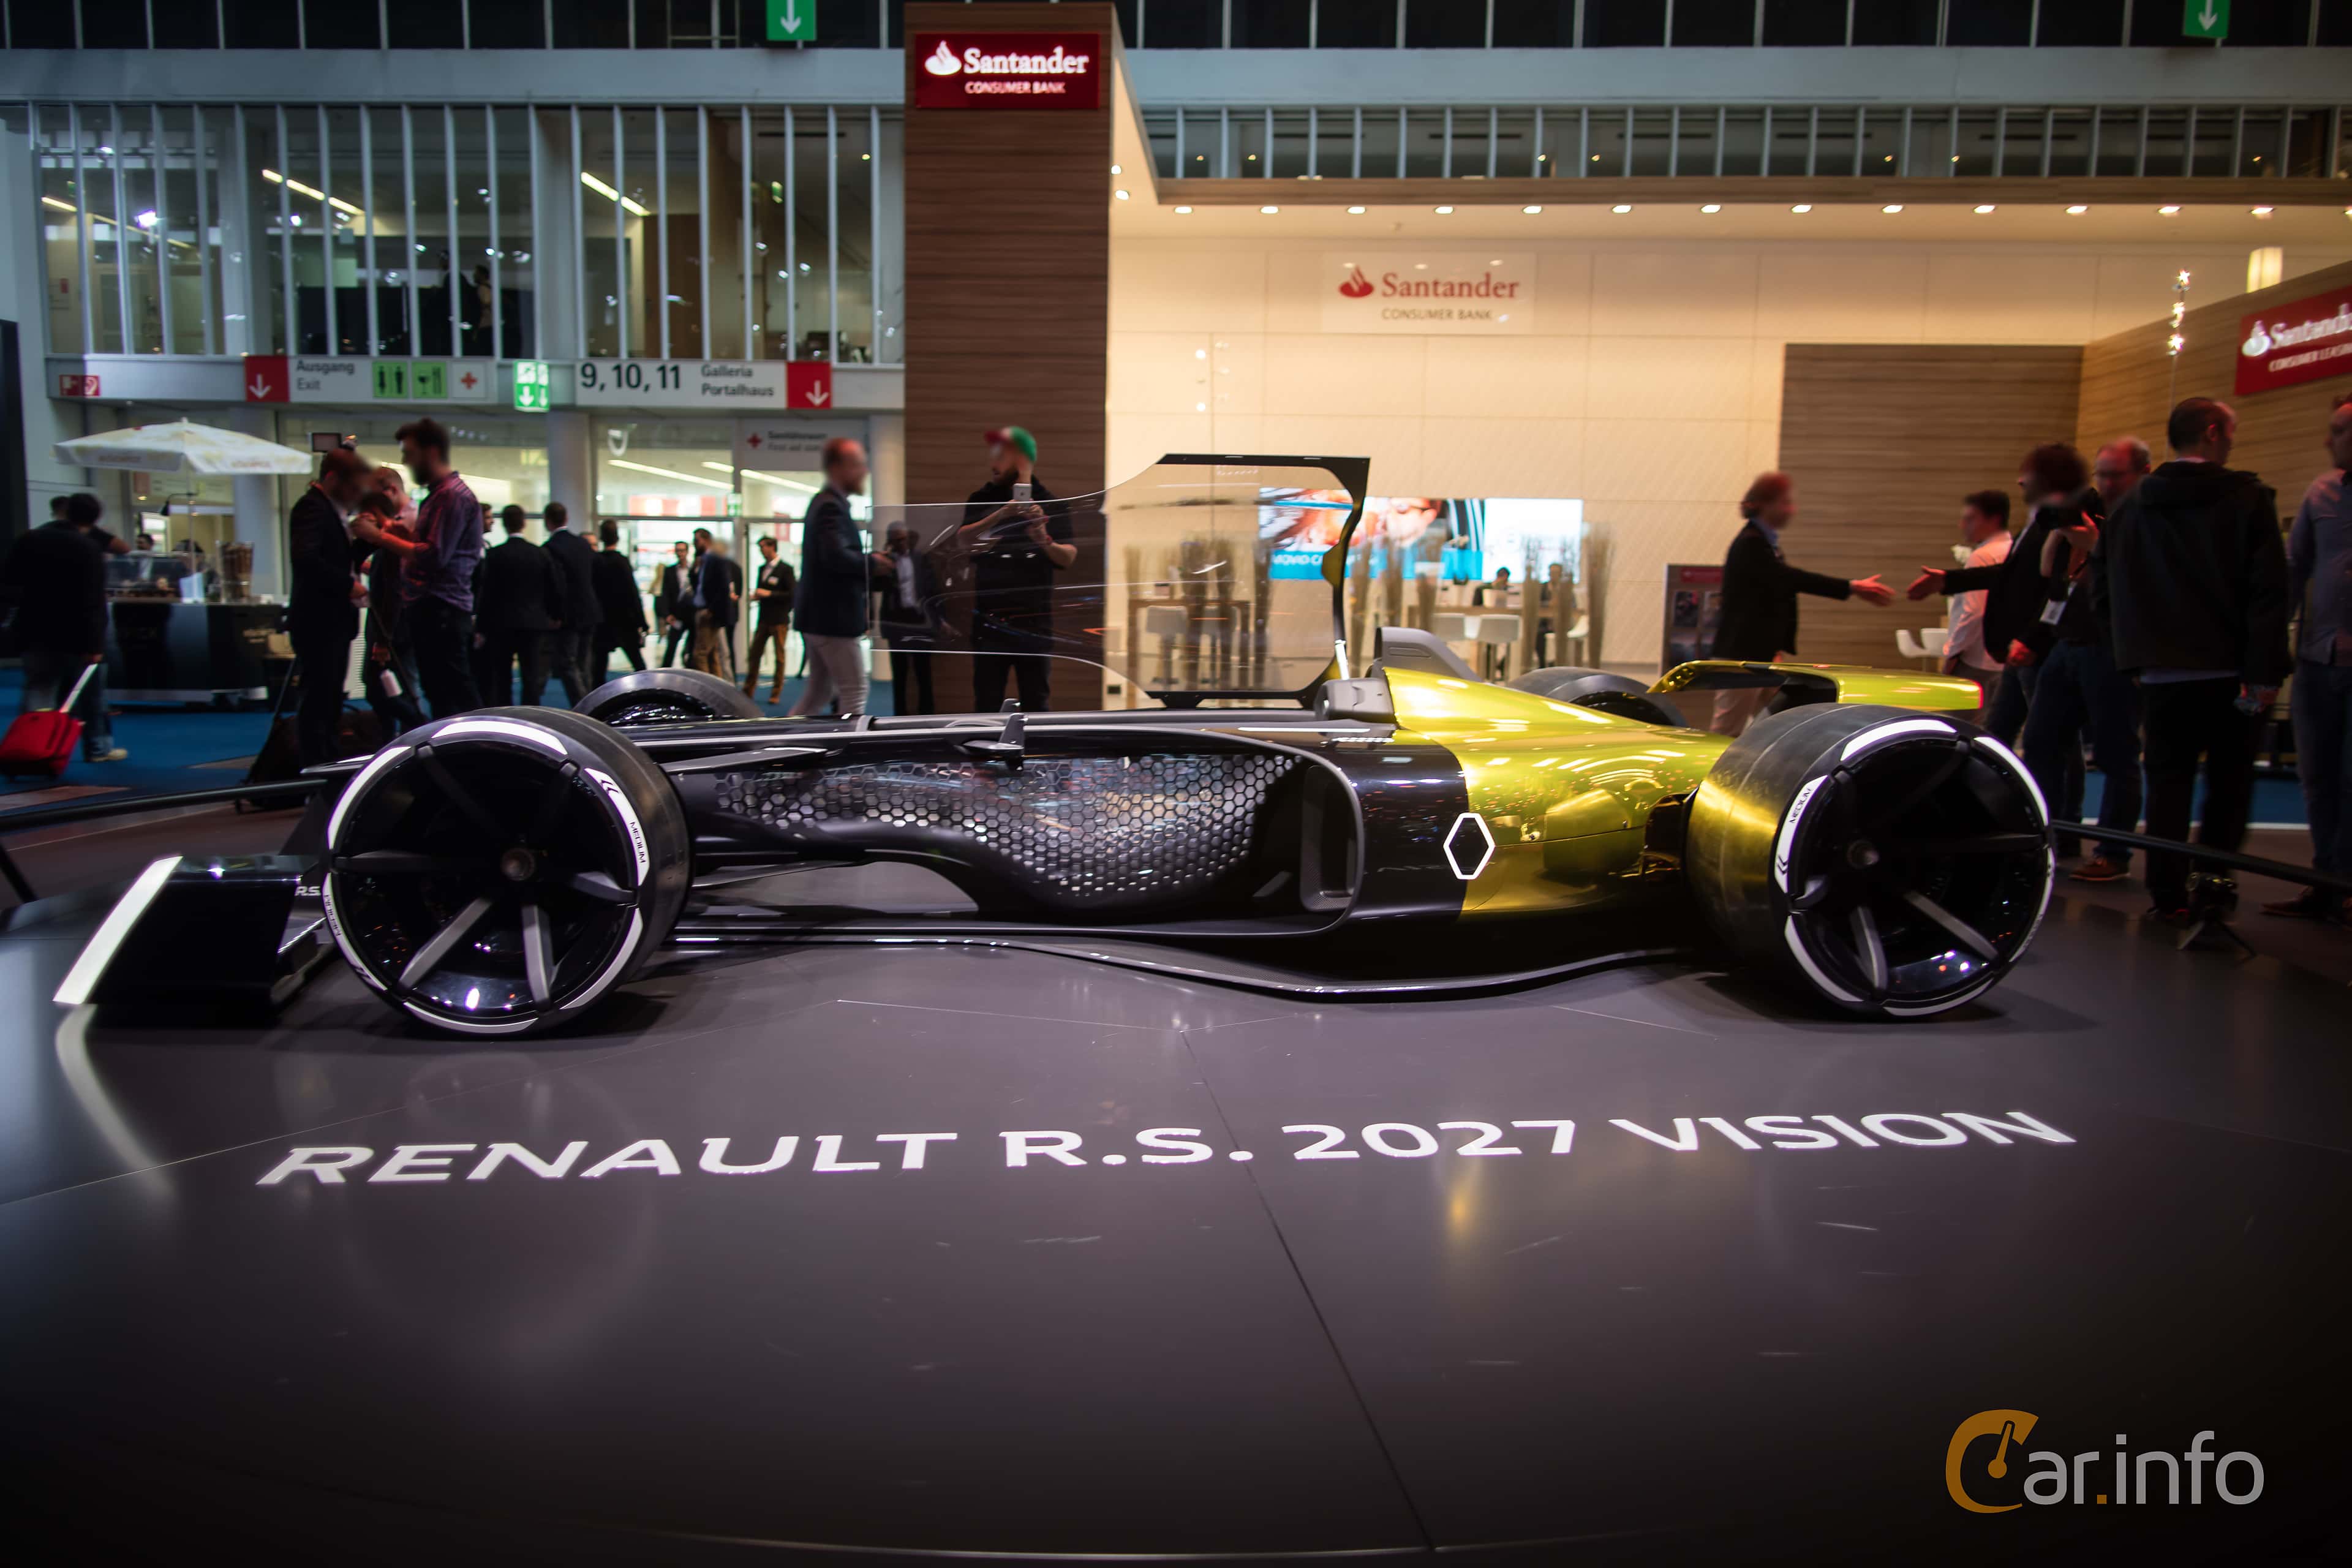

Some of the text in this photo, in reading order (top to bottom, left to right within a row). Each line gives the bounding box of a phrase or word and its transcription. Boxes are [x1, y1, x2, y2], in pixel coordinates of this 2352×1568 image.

[963, 45, 1090, 74] Santander
[965, 81, 1066, 94] CONSUMER BANK
[1381, 271, 1521, 298] Santander
[1382, 308, 1493, 320] CONSUMER BANK
[296, 360, 355, 376] Ausgang
[701, 364, 753, 378] Galleria
[297, 377, 321, 391] Exit
[581, 363, 681, 392] 9, 10, 11
[701, 383, 775, 396] Portalhaus
[630, 821, 646, 863] MEDIUM
[255, 1112, 2078, 1185] RENAULT R.S. 2027 VISION
